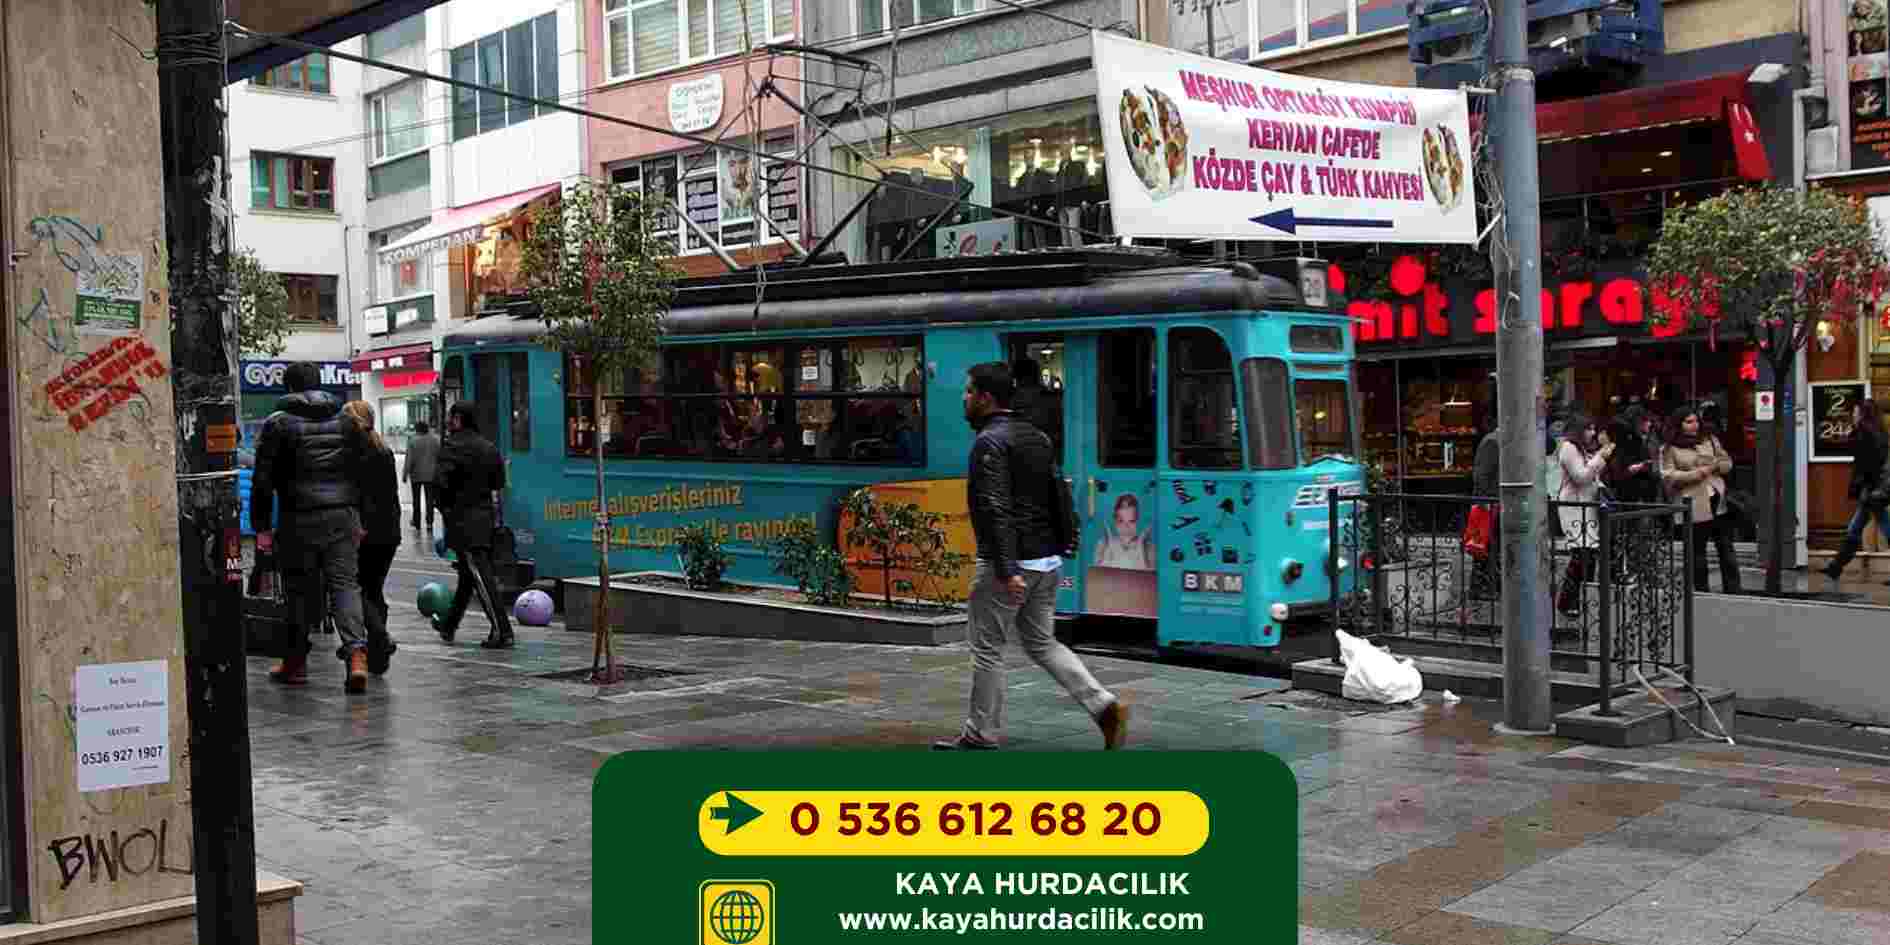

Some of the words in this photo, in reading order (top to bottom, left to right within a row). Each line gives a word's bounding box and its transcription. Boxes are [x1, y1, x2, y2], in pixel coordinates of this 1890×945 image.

[1177, 70, 1265, 112] MEŞHUR
[1262, 86, 1347, 119] ORTAKÖY
[1247, 118, 1317, 155] KERVAN
[1192, 147, 1258, 192] KÖZDE
[1261, 160, 1295, 202] ÇAY
[1300, 164, 1314, 195] &
[1316, 158, 1360, 198] TÜRK
[1184, 573, 1242, 591] BKM
[113, 748, 133, 762] 927
[138, 745, 163, 759] 1907
